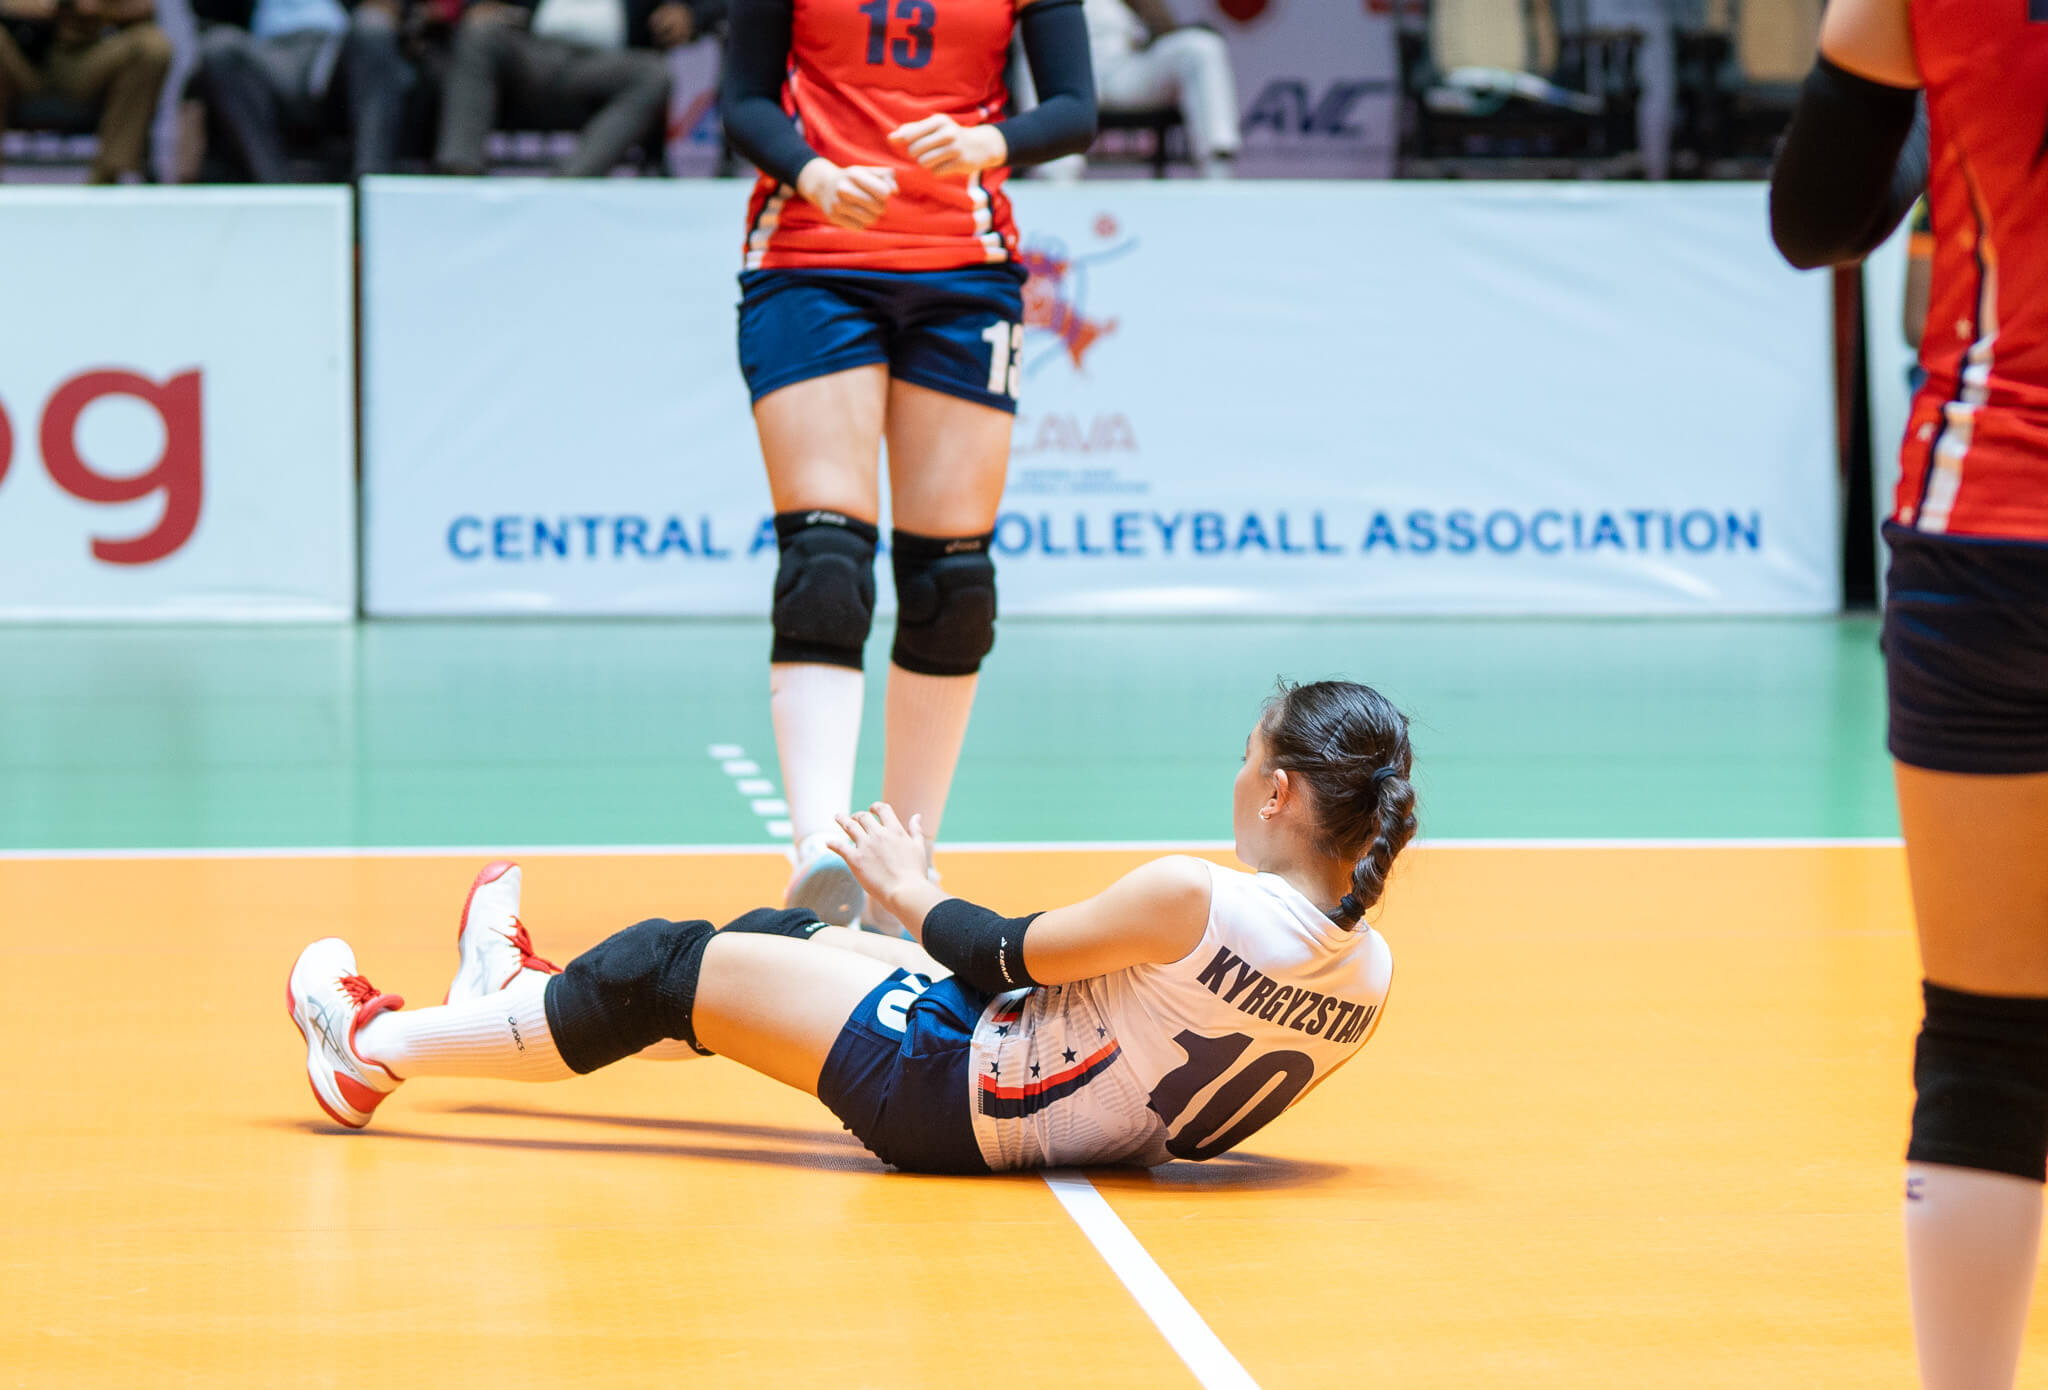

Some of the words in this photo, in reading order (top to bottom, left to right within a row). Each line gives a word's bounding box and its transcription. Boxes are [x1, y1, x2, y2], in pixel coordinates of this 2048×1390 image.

[859, 0, 936, 69] 13
[1240, 77, 1396, 136] AVC
[447, 514, 731, 560] CENTRAL
[993, 512, 1344, 557] OLLEYBALL
[1362, 510, 1762, 555] ASSOCIATION
[1196, 945, 1378, 1044] KYRGYZSTAN
[1146, 1028, 1315, 1162] 10
